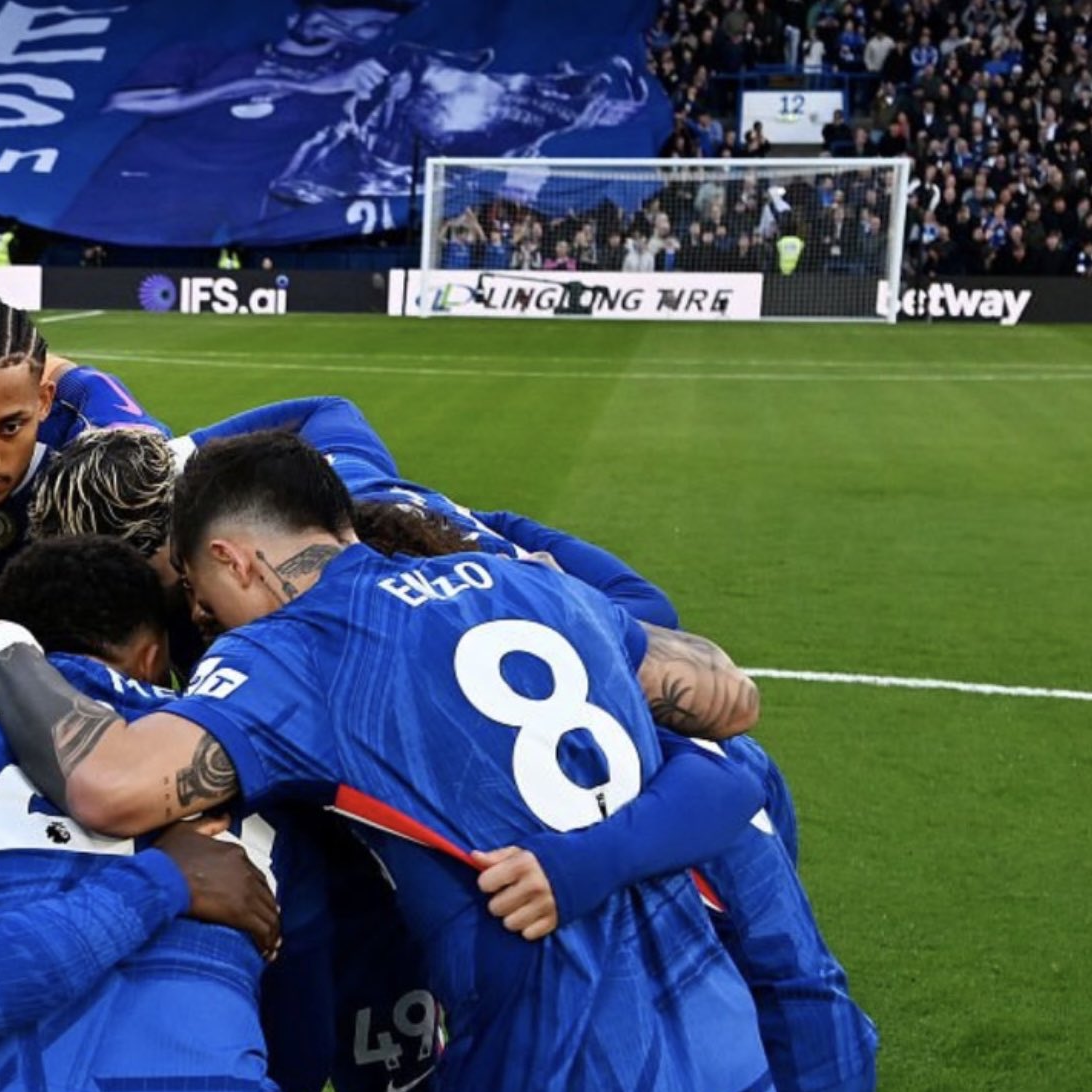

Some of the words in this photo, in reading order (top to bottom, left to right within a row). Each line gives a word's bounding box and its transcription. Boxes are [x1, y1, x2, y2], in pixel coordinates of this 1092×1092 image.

[779, 94, 805, 114] 12
[179, 274, 290, 315] IFS.ai
[875, 279, 1032, 325] betway
[377, 561, 494, 607] ENZO
[453, 619, 642, 834] 8
[354, 989, 436, 1071] 49
